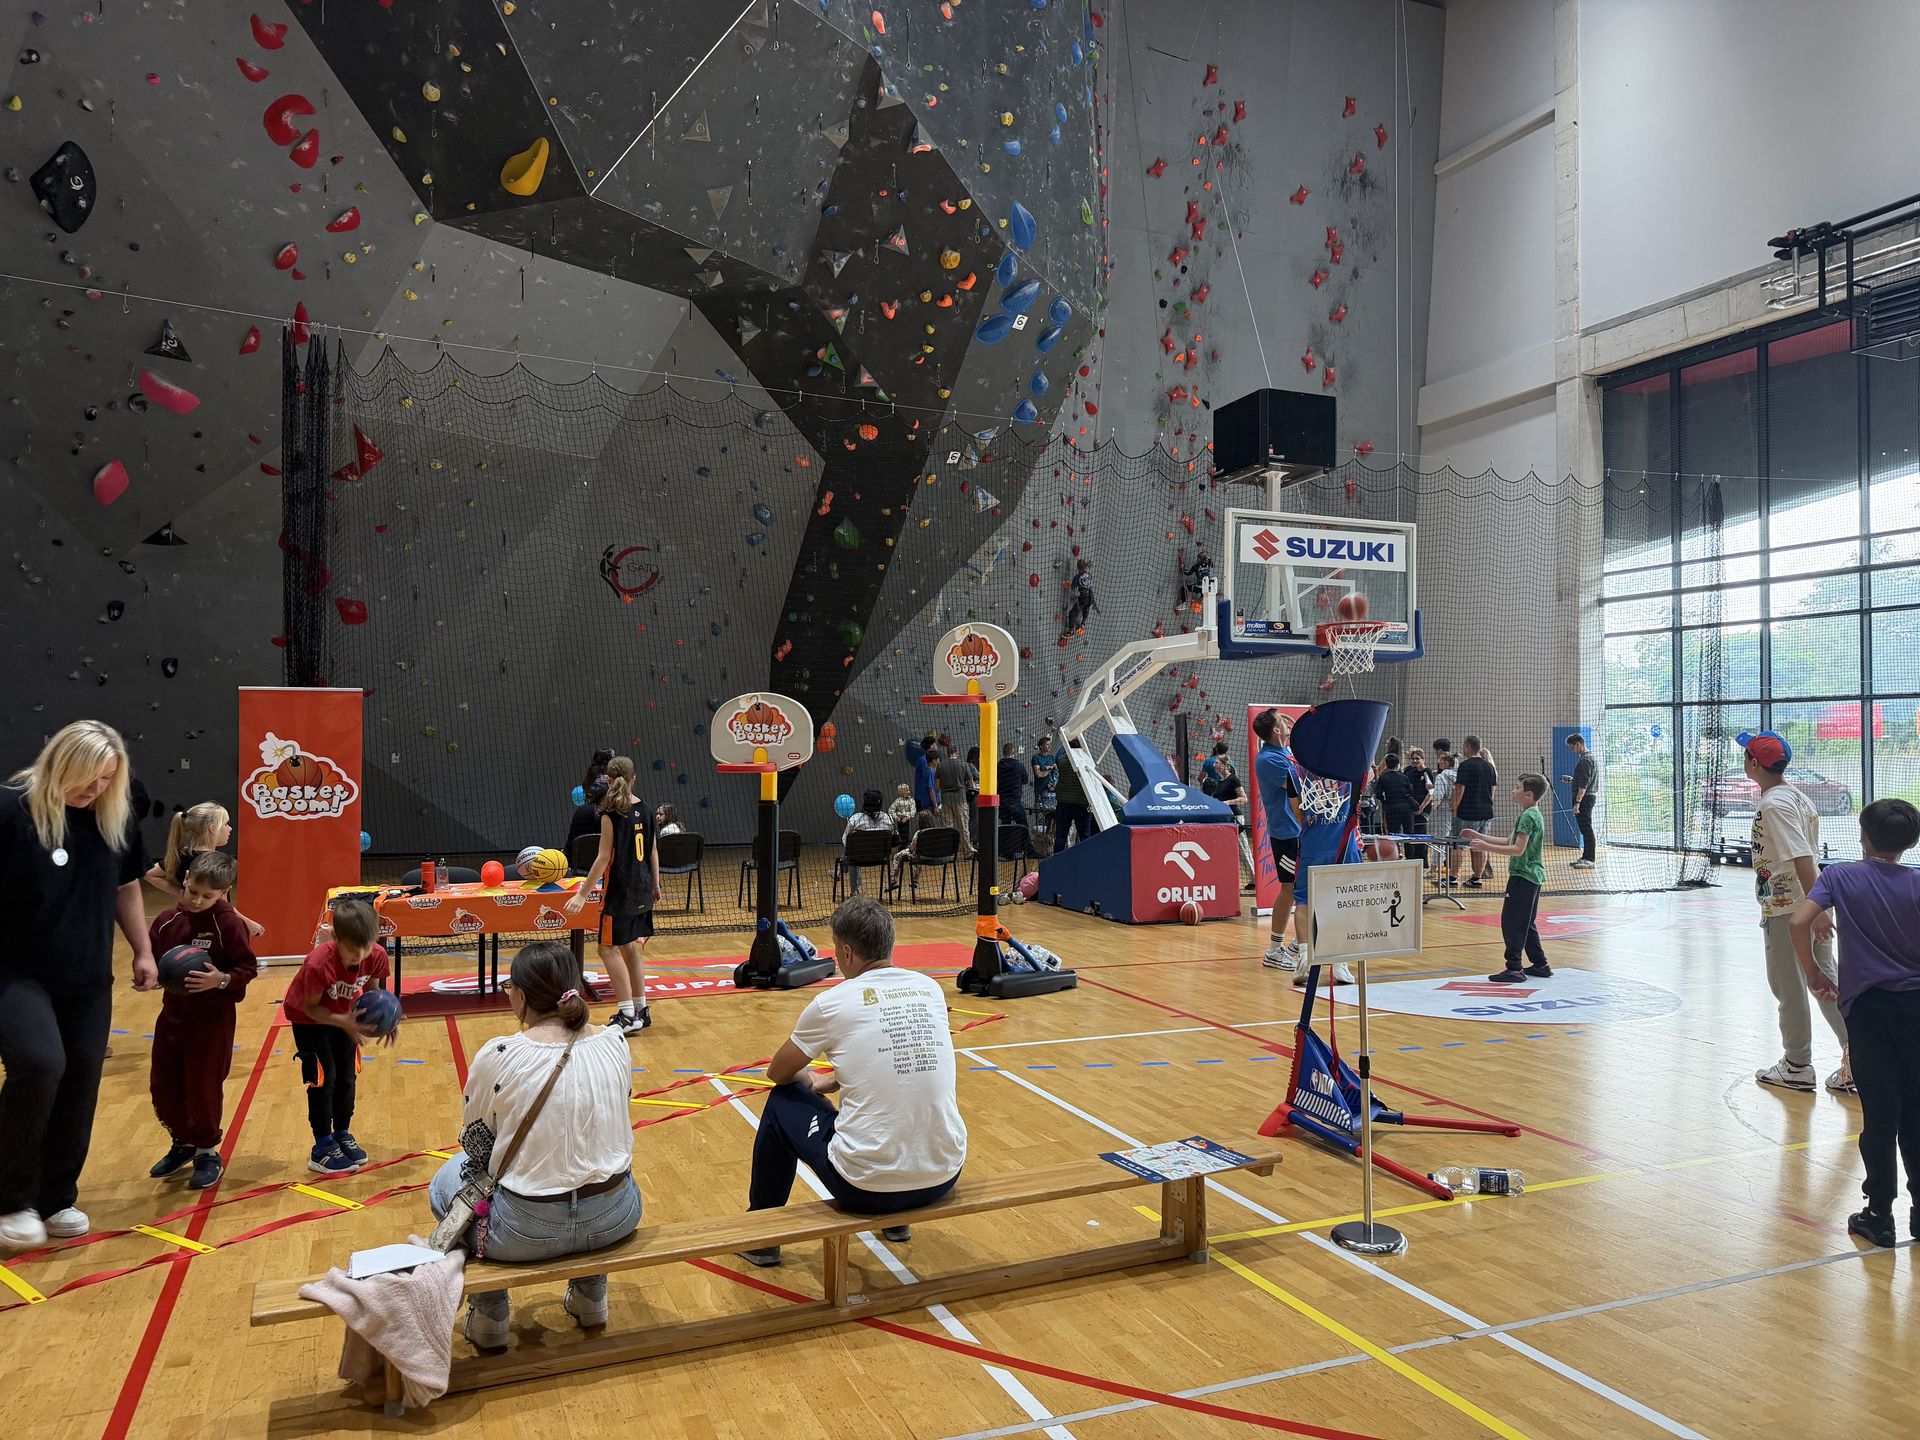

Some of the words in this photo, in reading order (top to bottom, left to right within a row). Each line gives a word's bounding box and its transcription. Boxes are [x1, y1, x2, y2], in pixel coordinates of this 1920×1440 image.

[1286, 536, 1394, 562] SUZUKI
[950, 653, 996, 666] Basket
[953, 662, 992, 676] Boom!
[734, 720, 788, 735] Basket
[736, 728, 784, 744] Boom!
[252, 783, 350, 800] Basket
[259, 795, 342, 814] Boom!
[634, 832, 644, 862] 0
[1156, 885, 1216, 904] ORLEN
[1336, 884, 1368, 894] TWARDE
[1370, 882, 1398, 892] PIERNIKI
[1337, 898, 1364, 909] BASKET
[1366, 896, 1388, 906] BOOM
[1346, 928, 1388, 941] koszykówka
[884, 990, 918, 1000] TRIATHLON
[1451, 994, 1614, 1016] SUZU
